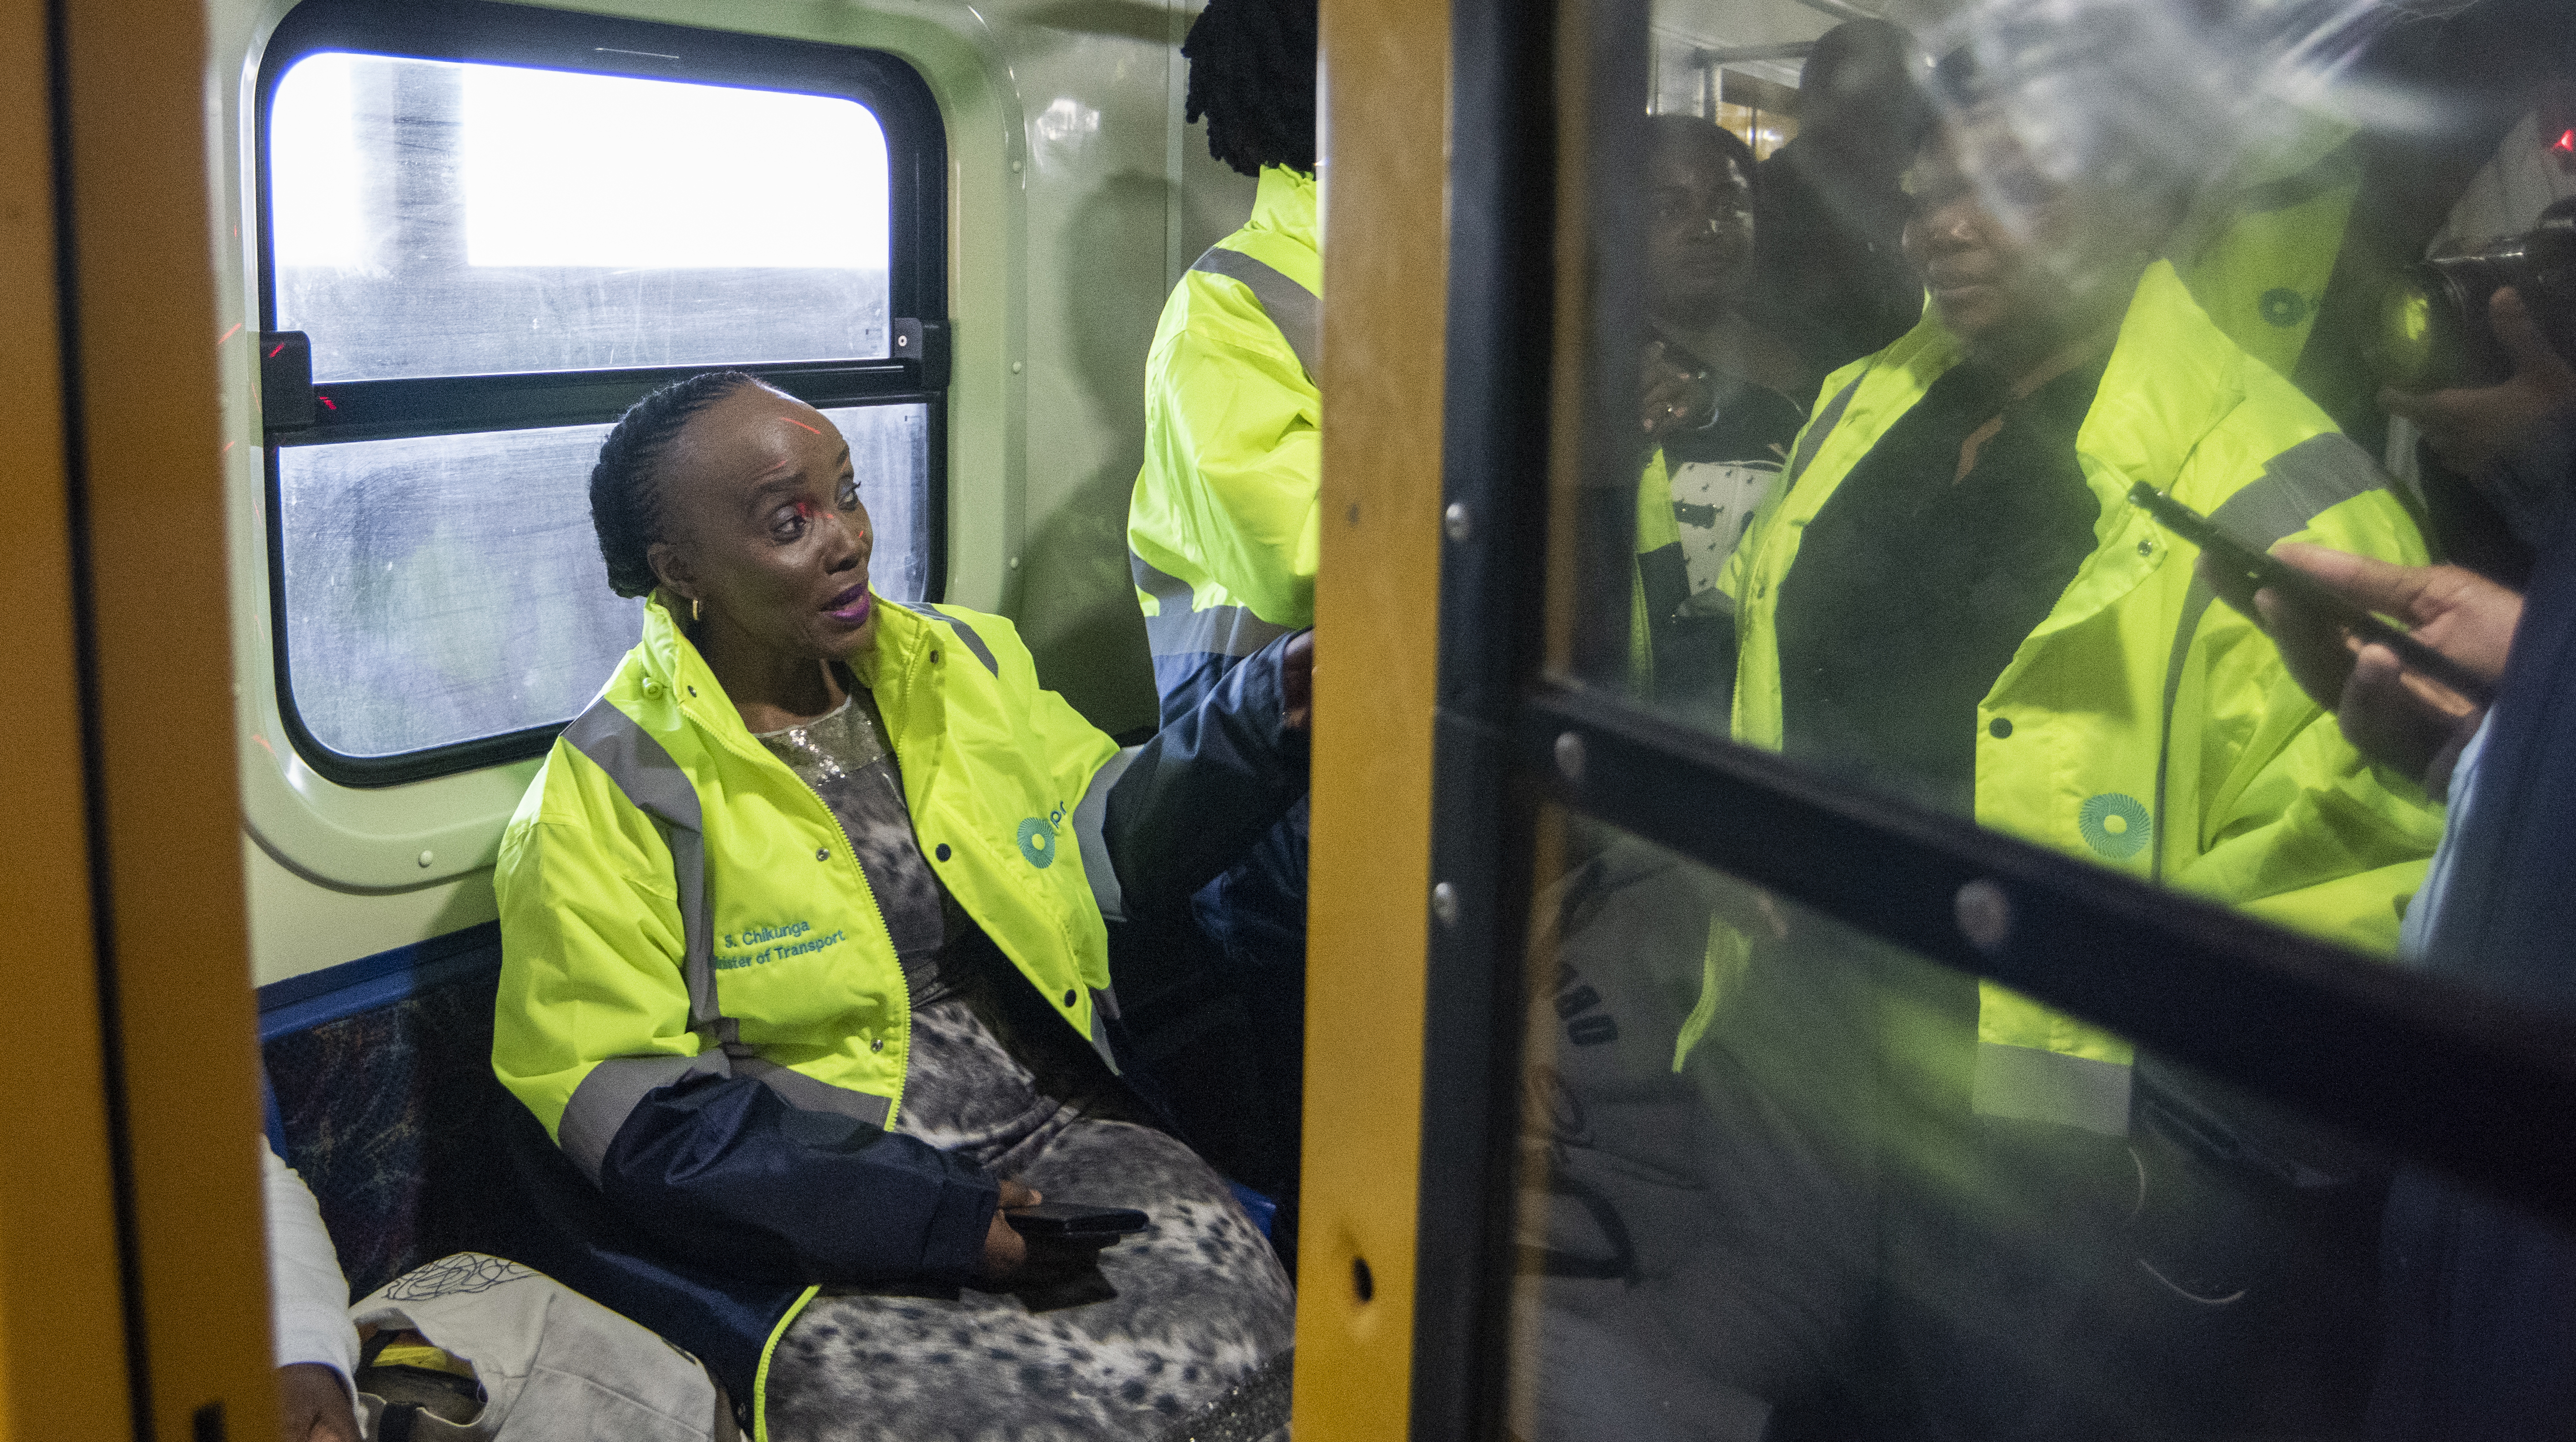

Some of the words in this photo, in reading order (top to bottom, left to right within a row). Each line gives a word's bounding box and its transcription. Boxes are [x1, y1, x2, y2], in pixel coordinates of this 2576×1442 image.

[725, 934, 737, 948] S.
[742, 921, 810, 945] Chikunga
[756, 948, 771, 965] of
[774, 929, 846, 960] Transport
